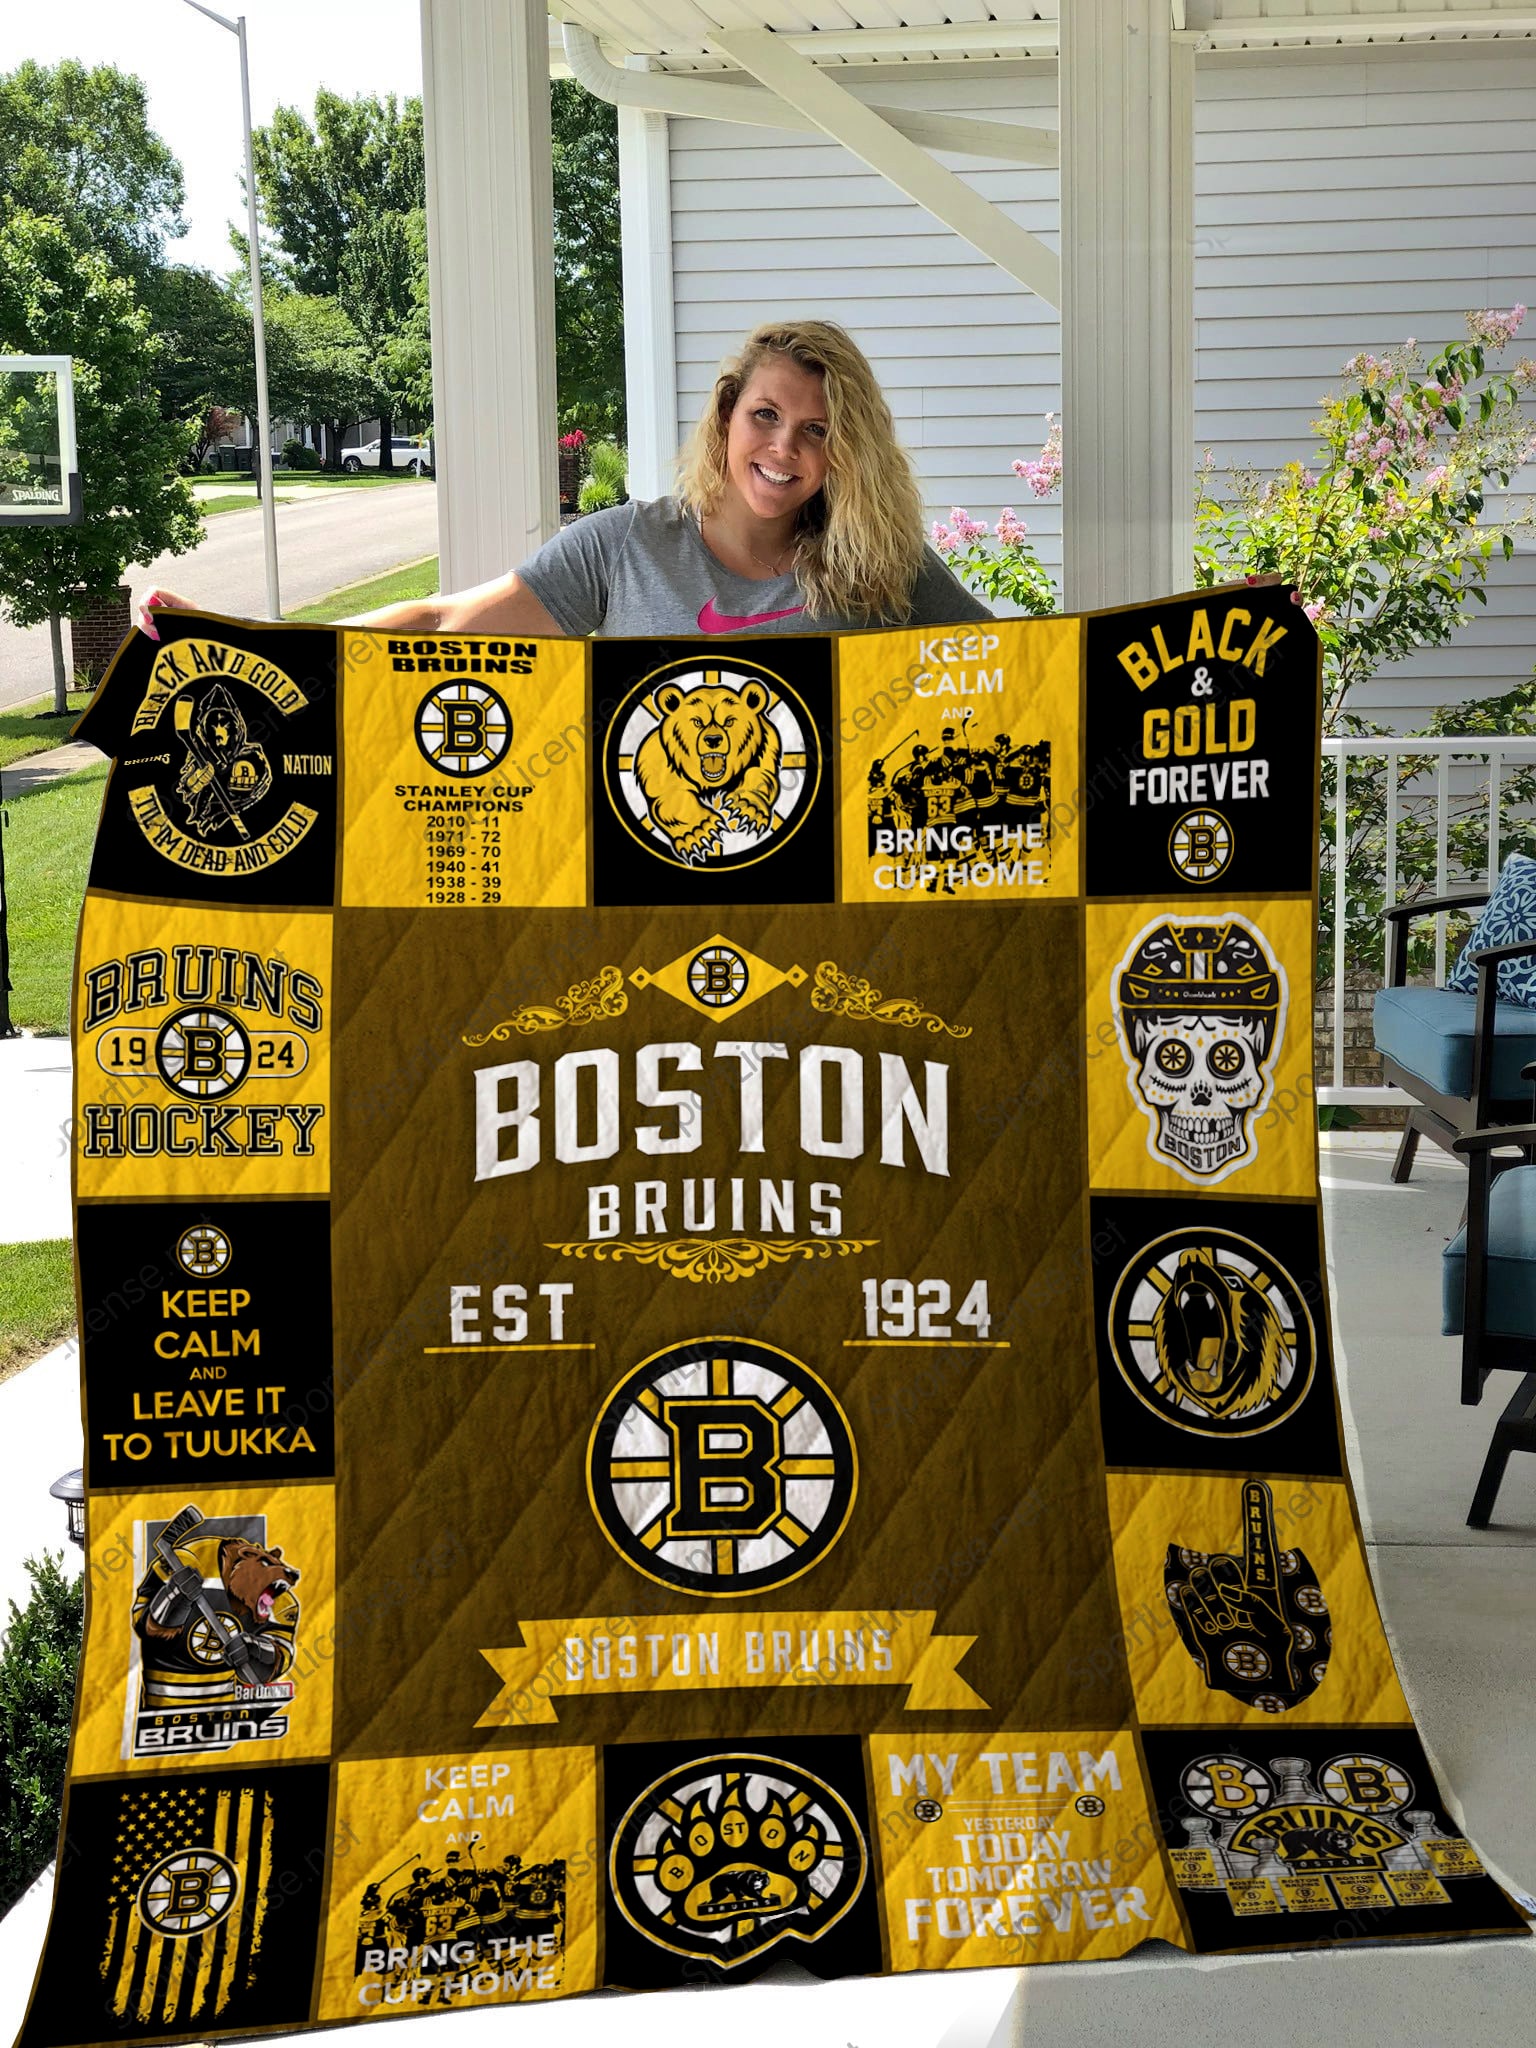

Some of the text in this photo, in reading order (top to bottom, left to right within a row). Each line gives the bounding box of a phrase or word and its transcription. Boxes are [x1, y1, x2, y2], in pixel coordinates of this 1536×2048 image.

[12, 489, 61, 502] SPALDING
[388, 640, 537, 658] BOSTON
[919, 635, 999, 665] KEEP
[1116, 607, 1288, 692] BLACK
[392, 658, 533, 674] BRUINS
[1191, 666, 1213, 696] &
[135, 643, 299, 728] BLACK AND GOLD
[914, 668, 1004, 698] CALM
[440, 701, 488, 756] B
[941, 707, 974, 720] AND
[1143, 698, 1256, 760] GOLD
[124, 753, 170, 765] BRUINS
[283, 754, 332, 775] NATION
[395, 785, 534, 798] STANLEY CUP
[1129, 759, 1270, 806] FOREVER
[403, 800, 524, 812] CHAMPIONS
[426, 816, 466, 827] 2010
[481, 816, 499, 827] 11
[928, 796, 951, 817] 63
[178, 839, 228, 873] DEAD
[234, 844, 269, 872] AND
[268, 810, 308, 855] COLD
[426, 831, 466, 843] 1971
[481, 831, 501, 843] 72
[426, 846, 466, 857] 1969
[481, 846, 501, 857] 70
[876, 824, 1044, 854] BRING THE
[1187, 825, 1216, 866] B
[426, 861, 466, 873] 1940
[481, 861, 501, 873] 41
[426, 876, 466, 888] 1938
[481, 876, 501, 888] 39
[874, 861, 1044, 890] CUP HOME
[426, 891, 466, 903] 1928
[481, 891, 501, 903] 29
[83, 945, 323, 1033] BRUINS
[704, 960, 732, 996] B
[181, 1026, 226, 1080] B
[473, 1040, 950, 1182] BOSTON
[84, 1104, 324, 1157] HOCKEY
[1164, 1134, 1240, 1168] BOSTON
[587, 1178, 842, 1241] BRUINS
[162, 1289, 251, 1318] KEEP
[449, 1282, 575, 1344] EST
[861, 1277, 991, 1338] 1924
[154, 1329, 260, 1359] CALM
[189, 1366, 227, 1380] AND
[133, 1386, 286, 1420] LEAVE IT
[103, 1427, 316, 1461] TO TUUKKA
[663, 1399, 783, 1538] B
[1249, 1489, 1266, 1581] BRUINS
[566, 1628, 893, 1682] BOSTON BRUINS
[138, 1717, 286, 1747] BRUINS
[425, 1764, 510, 1791] KEEP
[888, 1751, 1122, 1796] MY TEAM
[1206, 1763, 1256, 1809] B
[1339, 1765, 1392, 1804] B
[417, 1795, 514, 1823] CALM
[963, 1815, 1056, 1832] YESTERDAY
[445, 1831, 482, 1844] AND
[1238, 1809, 1392, 1848] BRUINS
[953, 1831, 1071, 1864] TODAY
[926, 1859, 1112, 1893] TOMORROW
[165, 1868, 213, 1918] B
[707, 1899, 771, 1913] BRUINS
[426, 1915, 452, 1936] 63
[904, 1886, 1154, 1941] FOREVER
[364, 1934, 557, 1973] BRING THE
[358, 1966, 556, 2006] CUP HOME
